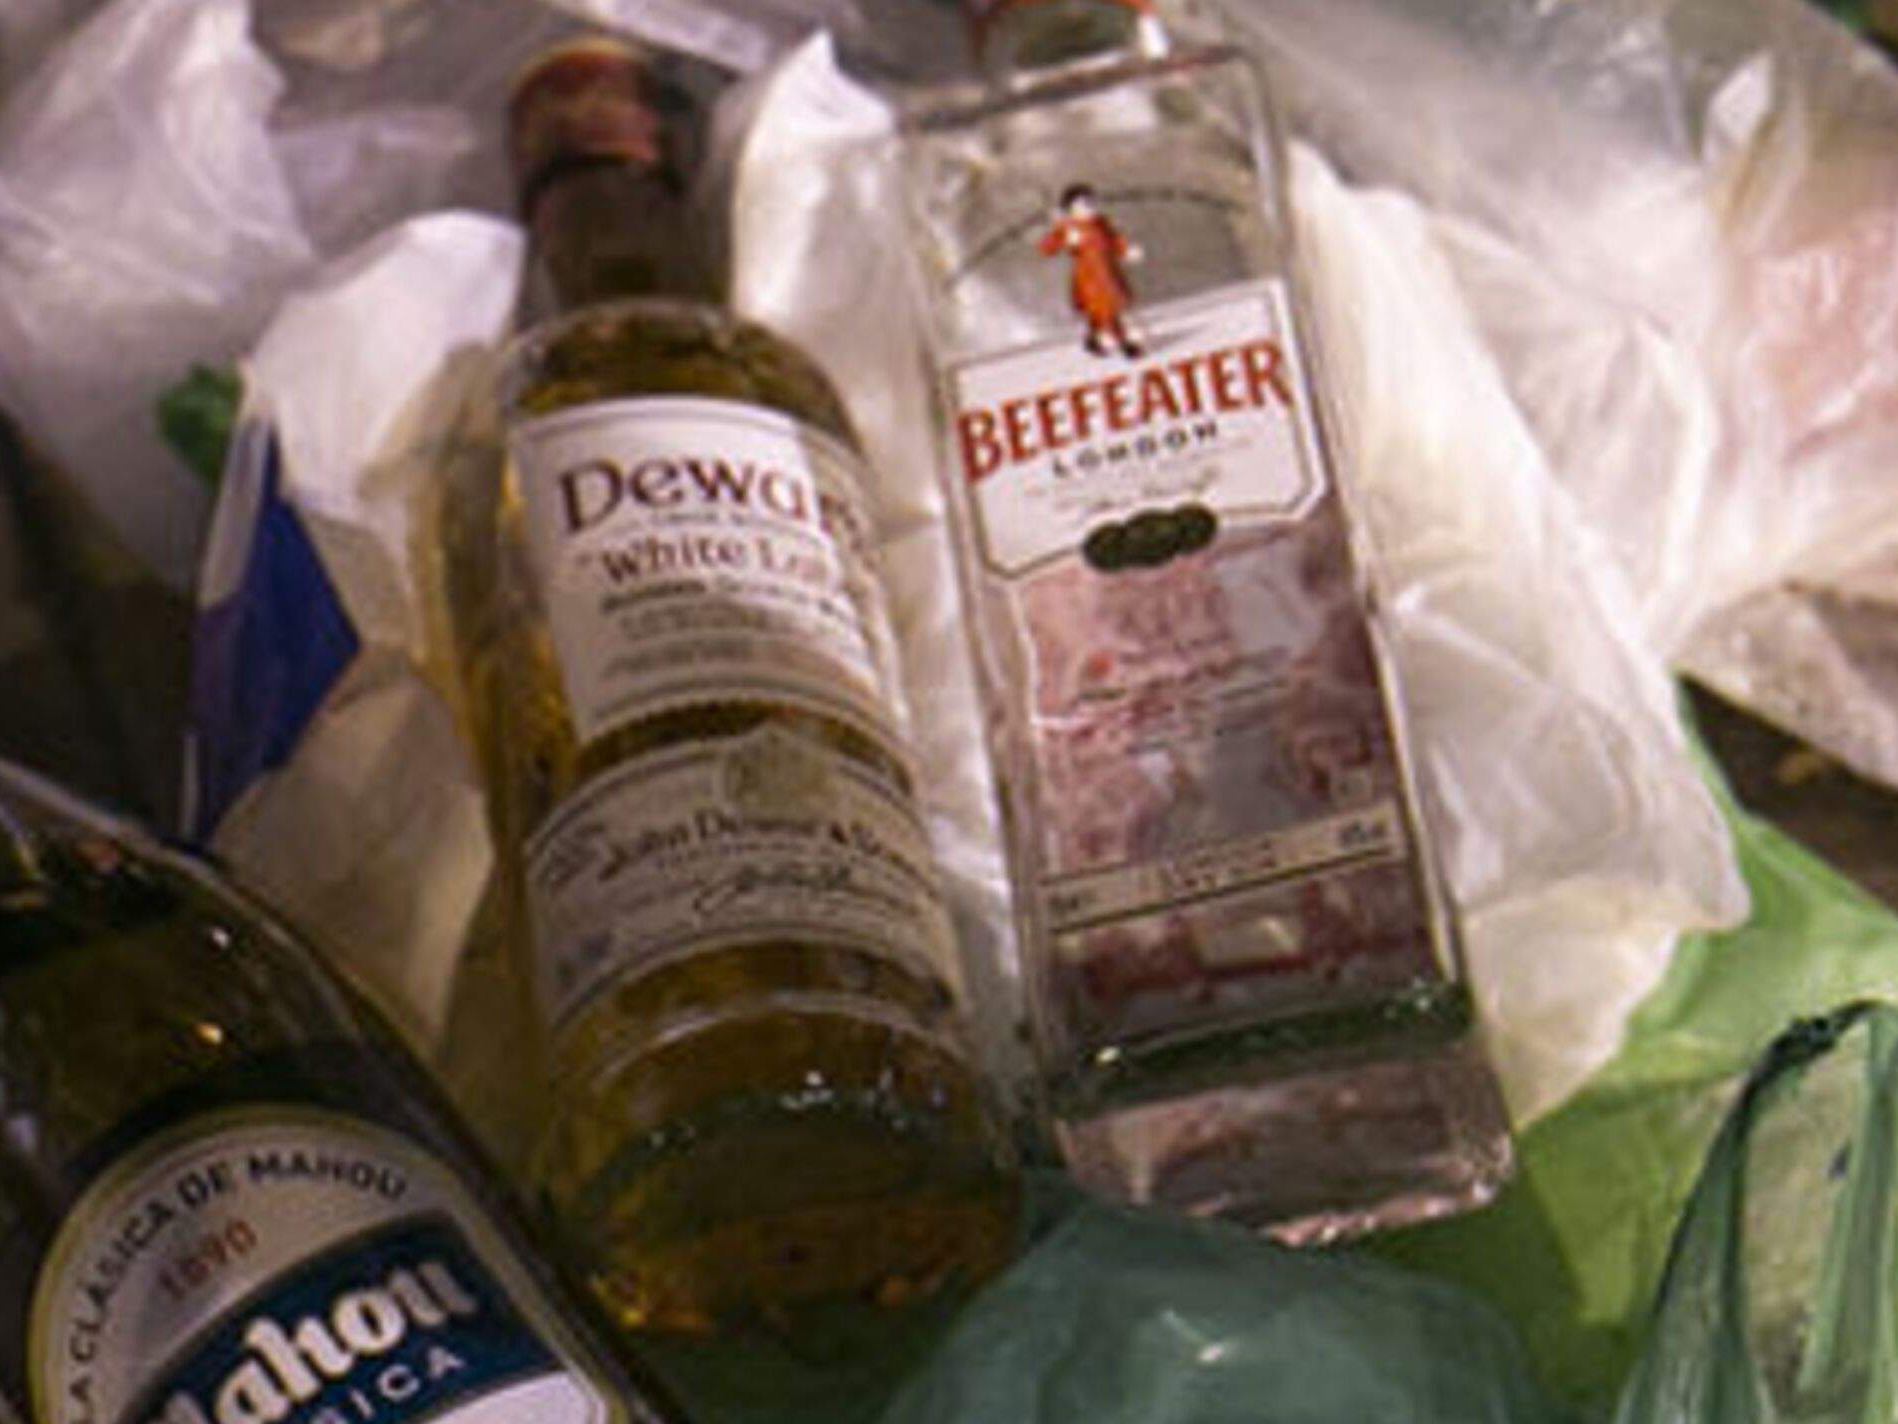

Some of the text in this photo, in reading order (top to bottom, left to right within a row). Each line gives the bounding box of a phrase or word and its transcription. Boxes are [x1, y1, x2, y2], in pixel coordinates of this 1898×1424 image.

[956, 339, 1294, 487] BEEFEATER
[1050, 421, 1219, 478] LONDON
[177, 1162, 234, 1212] DE
[247, 1148, 409, 1203] MAHOU
